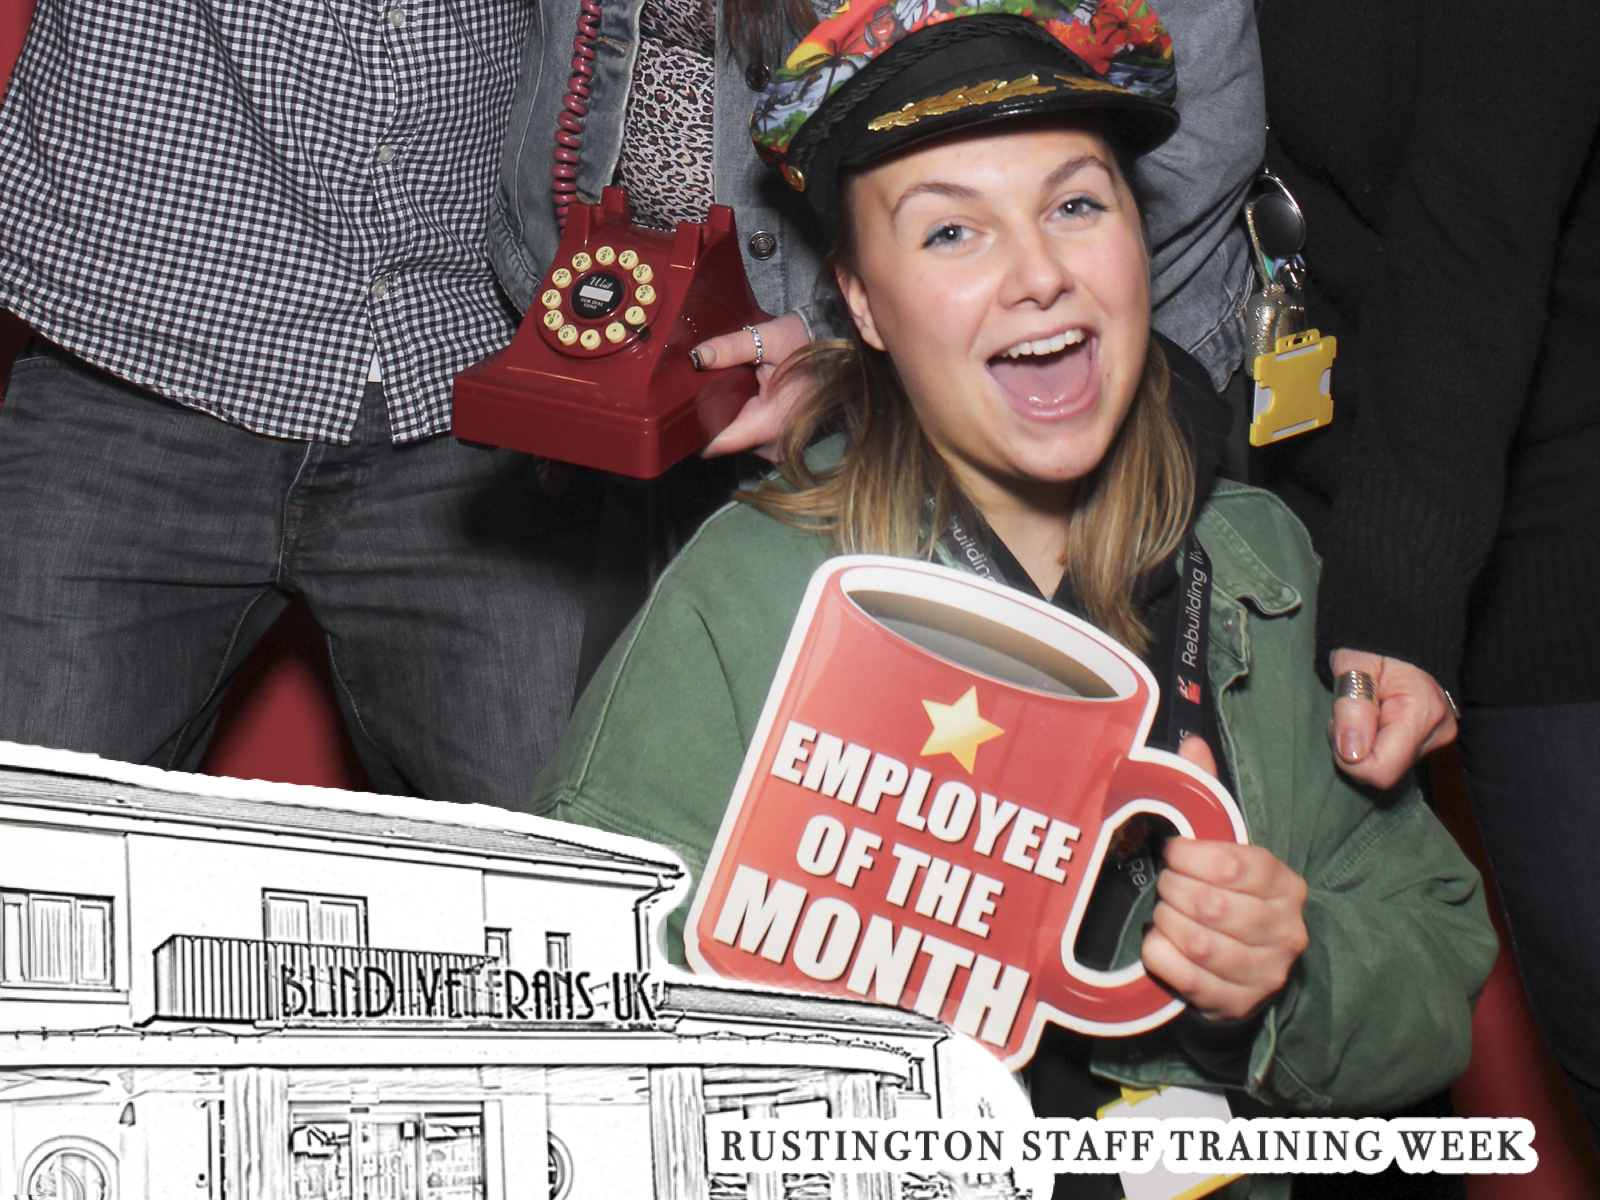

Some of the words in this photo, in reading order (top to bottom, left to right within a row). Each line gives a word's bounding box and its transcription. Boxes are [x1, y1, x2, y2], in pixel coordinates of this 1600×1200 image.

[600, 253, 607, 261] 5
[636, 270, 643, 278] 3
[555, 275, 562, 283] 7
[639, 291, 646, 299] 2
[547, 317, 555, 325] 9
[1181, 567, 1208, 668] Rebuilding
[770, 719, 1083, 885] EMPLOYEE
[795, 813, 884, 888] OF
[885, 842, 1005, 940] THE
[711, 863, 1032, 1048] MONTH
